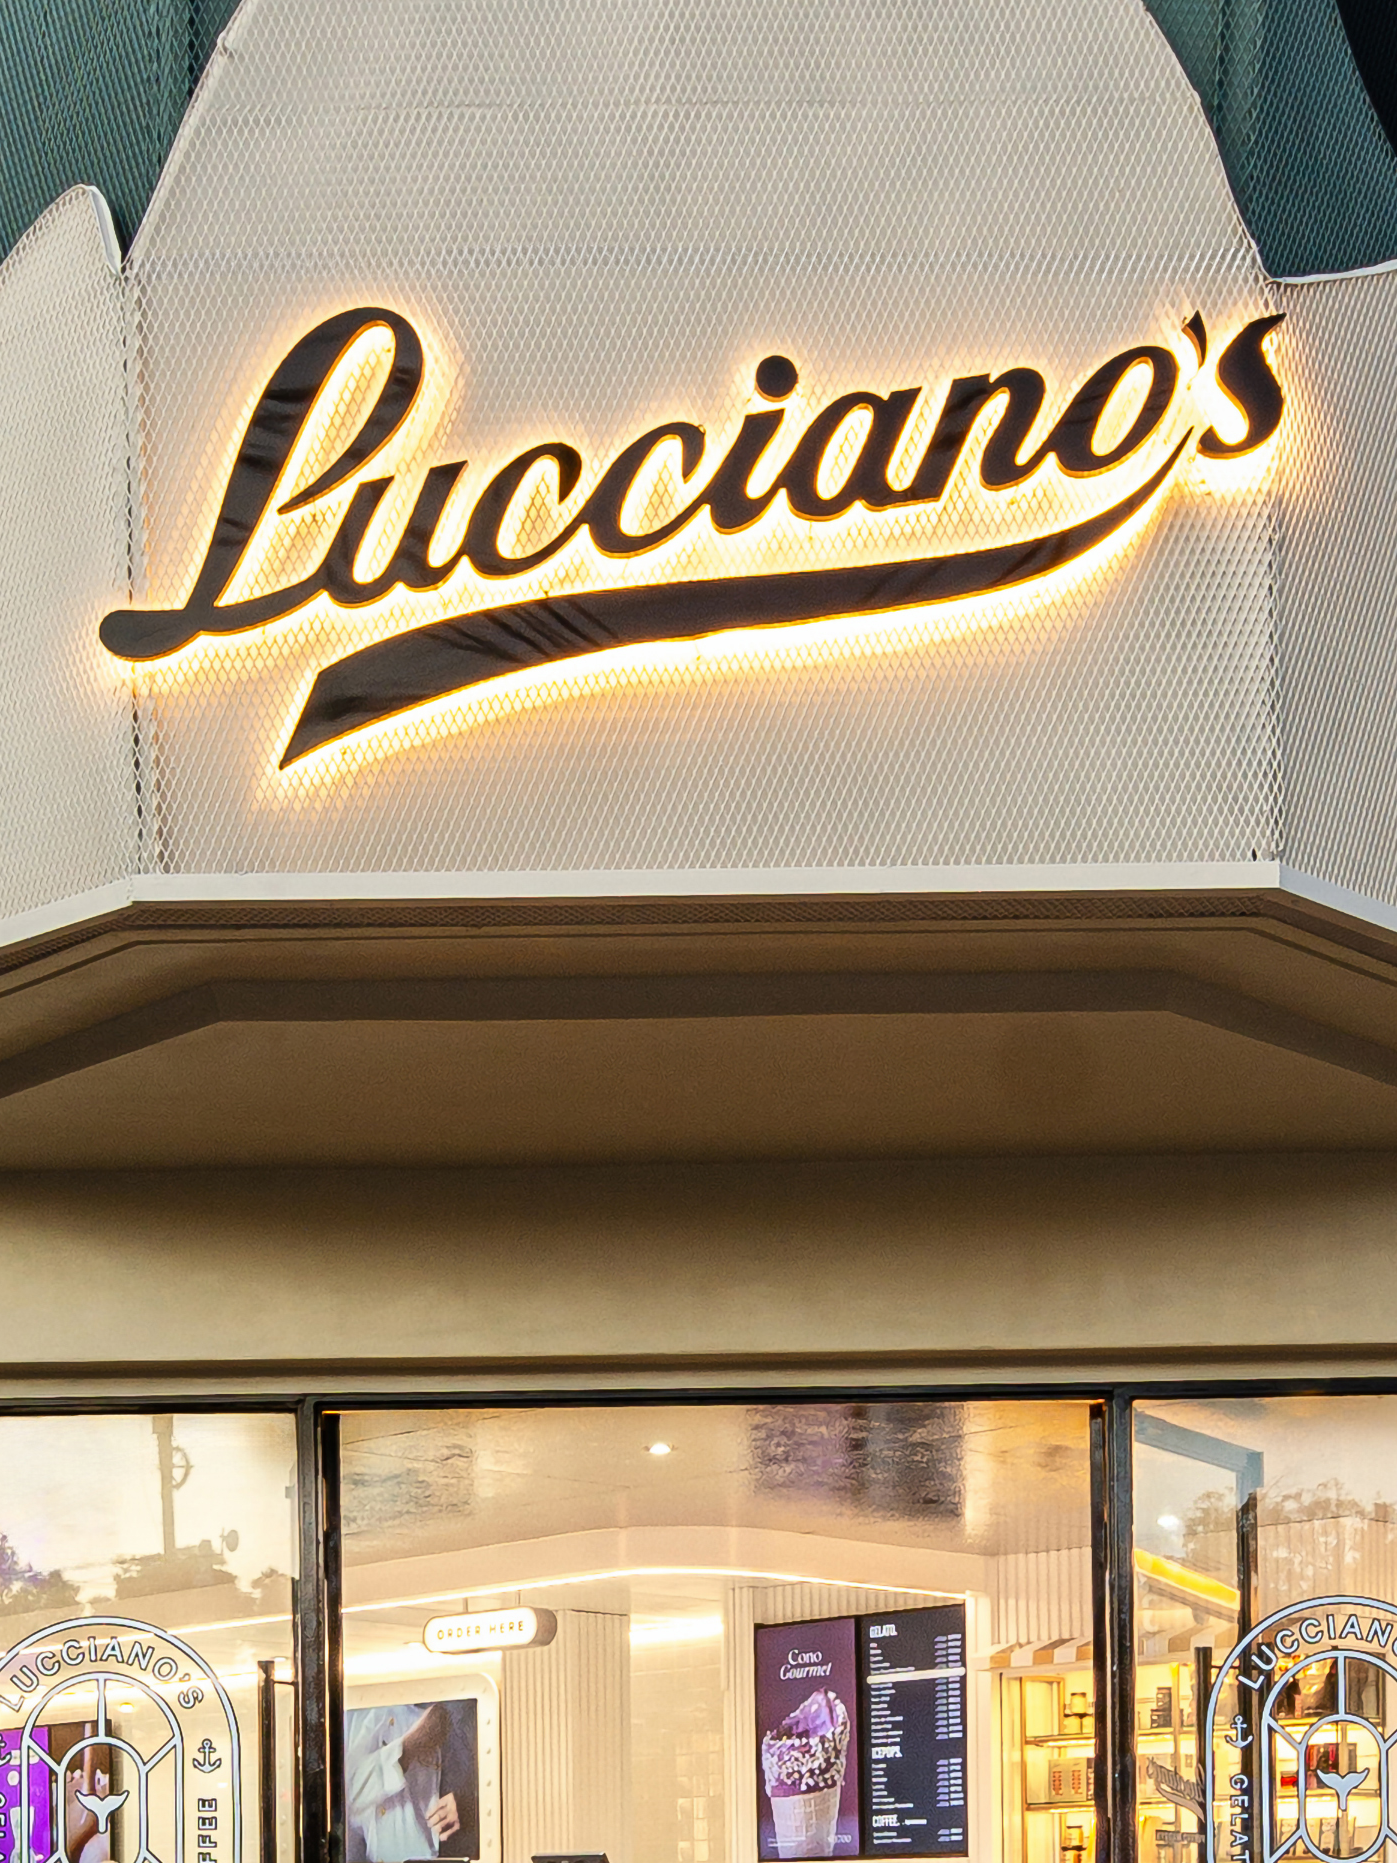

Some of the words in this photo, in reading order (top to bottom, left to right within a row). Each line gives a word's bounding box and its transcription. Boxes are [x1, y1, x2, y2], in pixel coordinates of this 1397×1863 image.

[98, 307, 1285, 768] Lucciano's
[437, 1625, 481, 1640] ORDER
[489, 1620, 524, 1634] HERE
[788, 1649, 823, 1665] Cono
[779, 1661, 833, 1681] Gourmet
